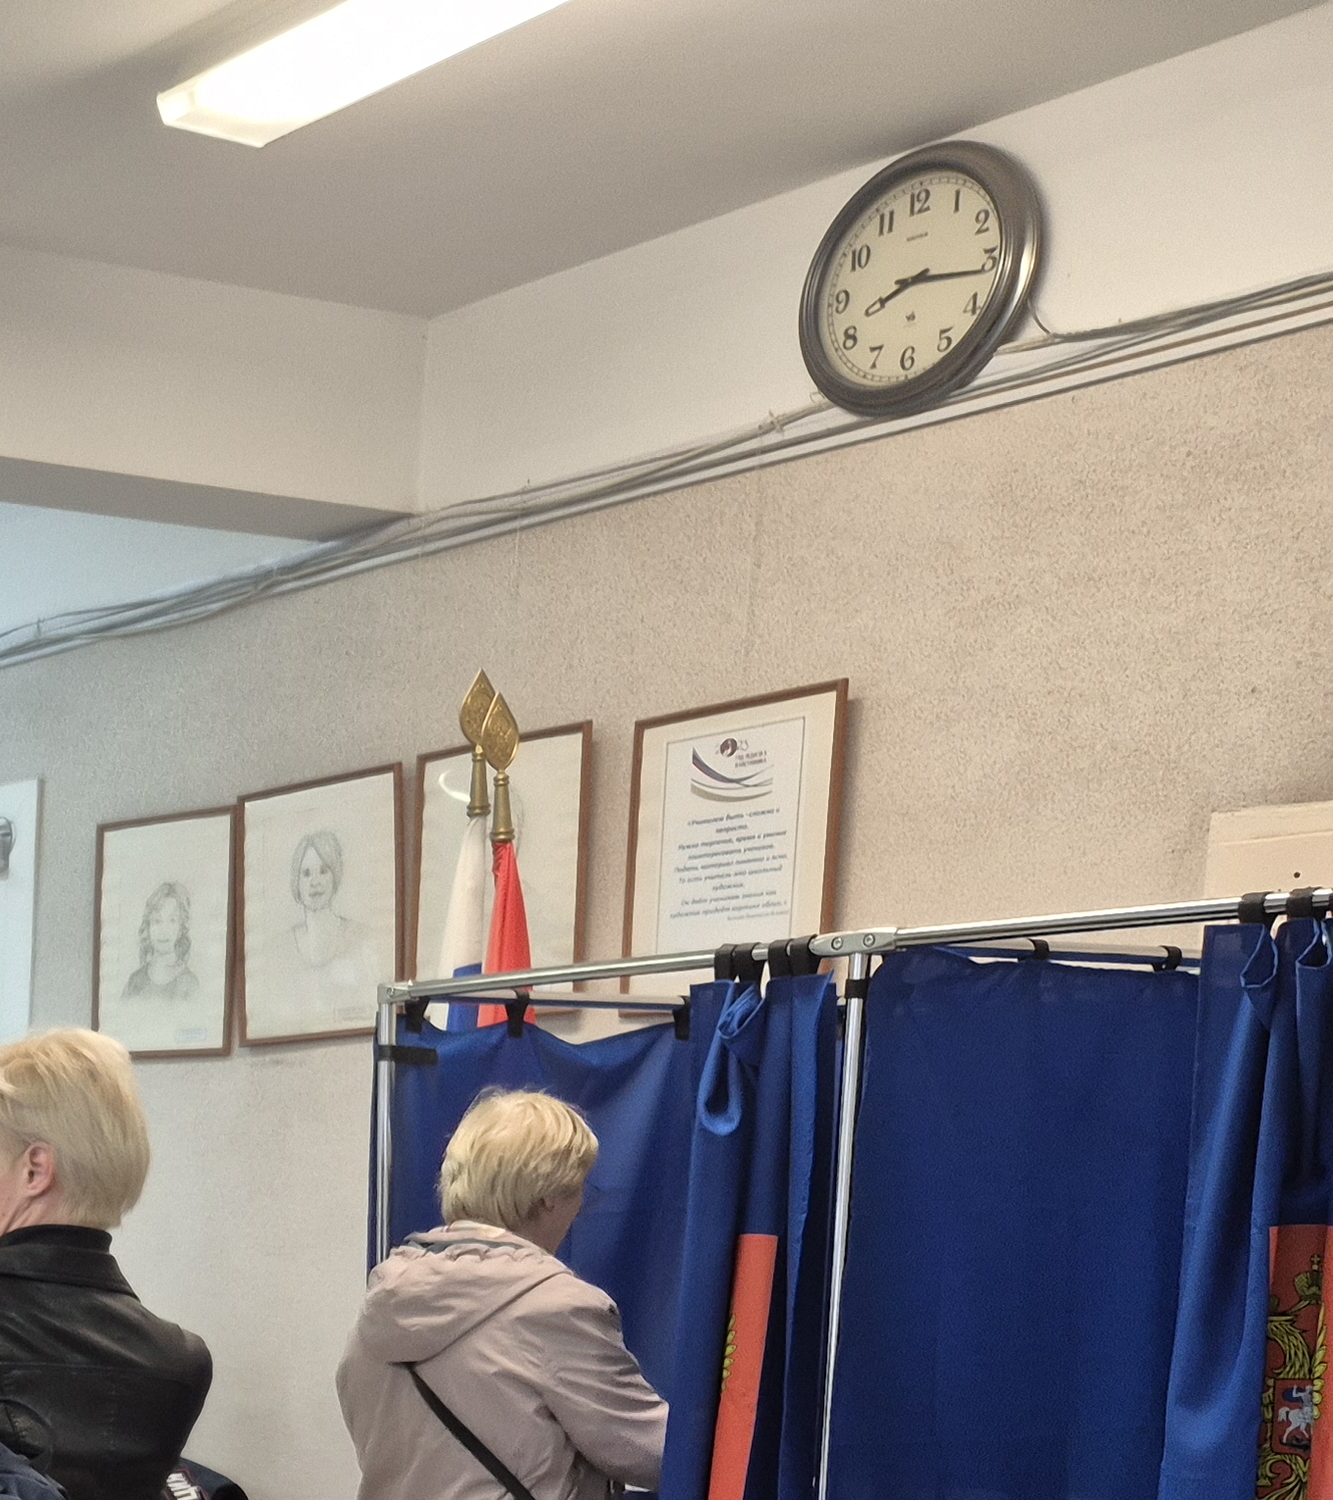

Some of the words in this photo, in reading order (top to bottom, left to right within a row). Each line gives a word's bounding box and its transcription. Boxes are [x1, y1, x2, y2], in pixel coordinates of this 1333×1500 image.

[908, 188, 931, 217] 12
[953, 189, 961, 213] 1
[878, 209, 895, 237] 11
[974, 209, 990, 236] 2
[849, 244, 871, 273] 10
[981, 246, 999, 273] 3
[835, 289, 850, 315] 9
[963, 292, 982, 317] 4
[842, 325, 858, 351] 8
[937, 326, 954, 352] 5
[869, 345, 884, 370] 7
[899, 346, 915, 371] 6
